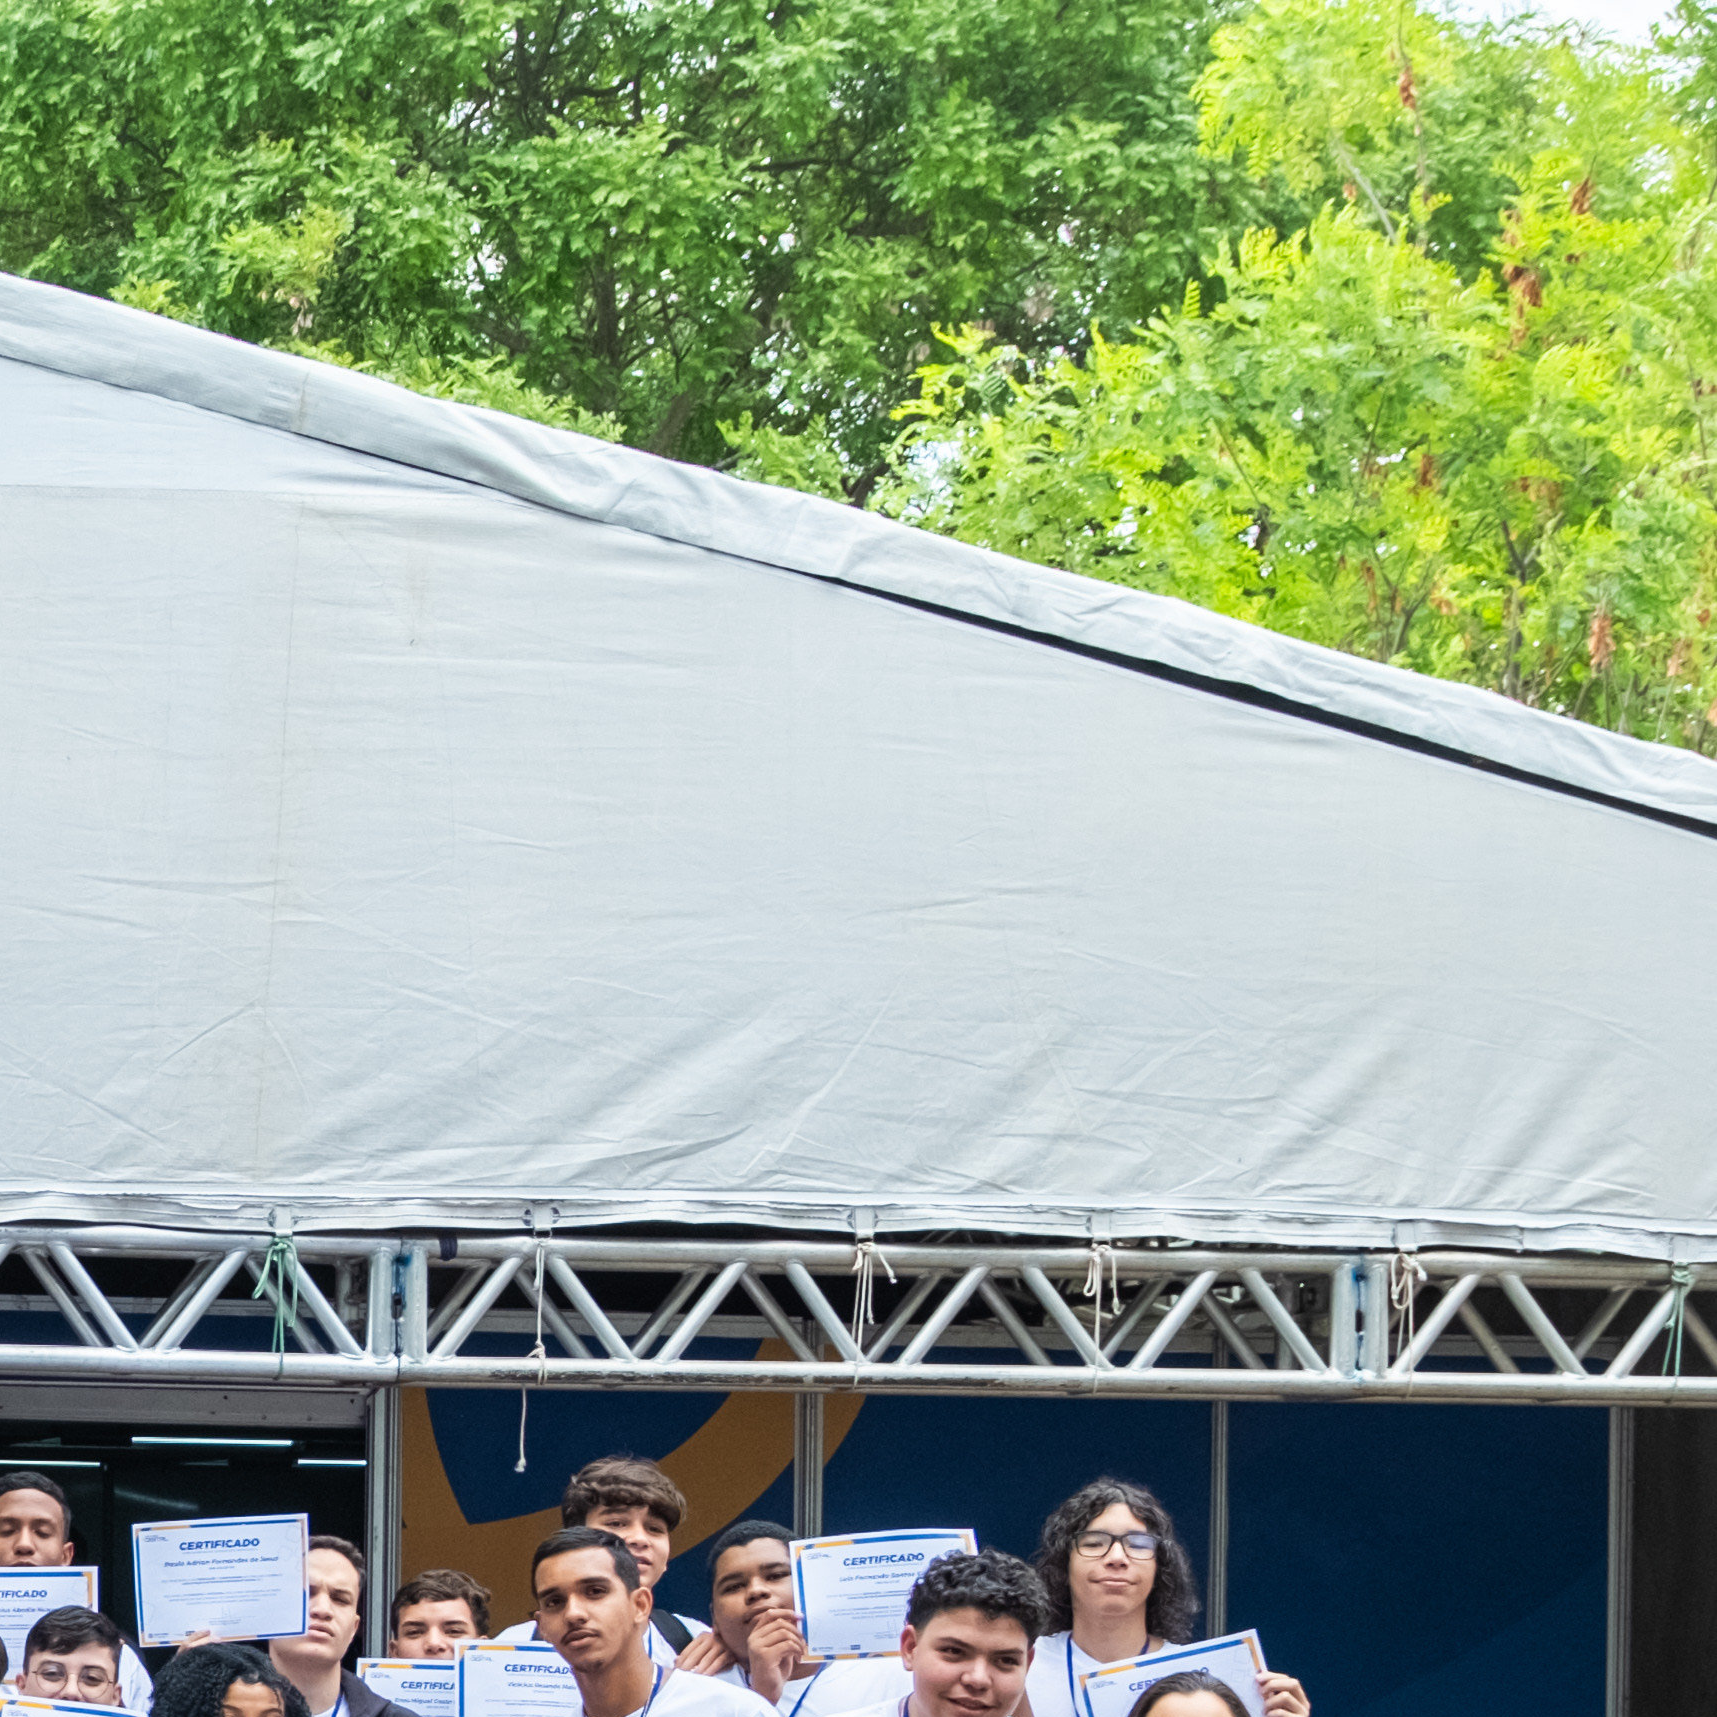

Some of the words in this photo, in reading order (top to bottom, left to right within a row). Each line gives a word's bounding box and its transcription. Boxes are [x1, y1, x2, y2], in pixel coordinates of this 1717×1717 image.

[179, 1538, 260, 1551] CERTIFICADO
[843, 1552, 925, 1567] CERTIFICADO
[504, 1664, 571, 1675] CERTIFICAD
[400, 1681, 455, 1690] CERTIFIC
